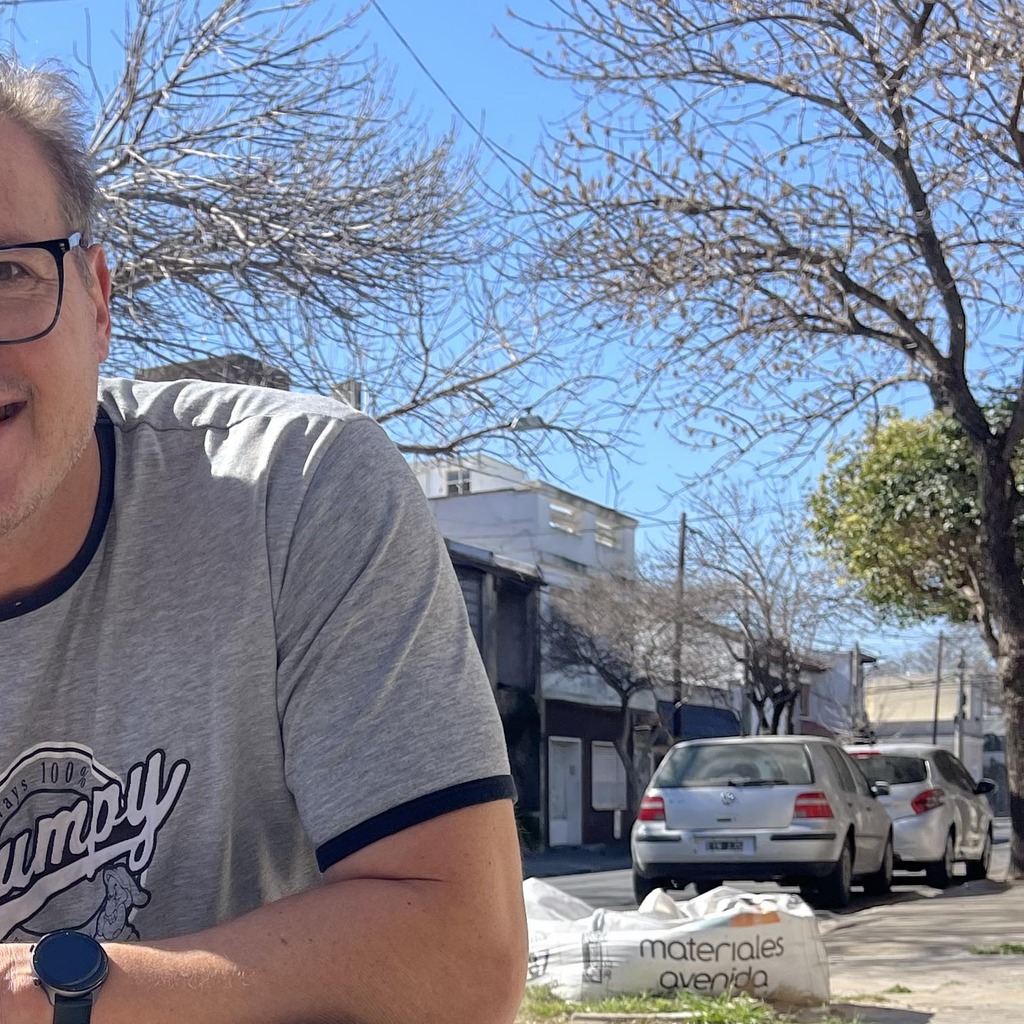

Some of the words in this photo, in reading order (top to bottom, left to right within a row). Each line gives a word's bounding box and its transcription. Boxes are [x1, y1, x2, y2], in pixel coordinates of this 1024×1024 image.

[40, 761, 89, 788] 100%
[639, 934, 784, 963] materiales
[659, 966, 768, 993] avenida
